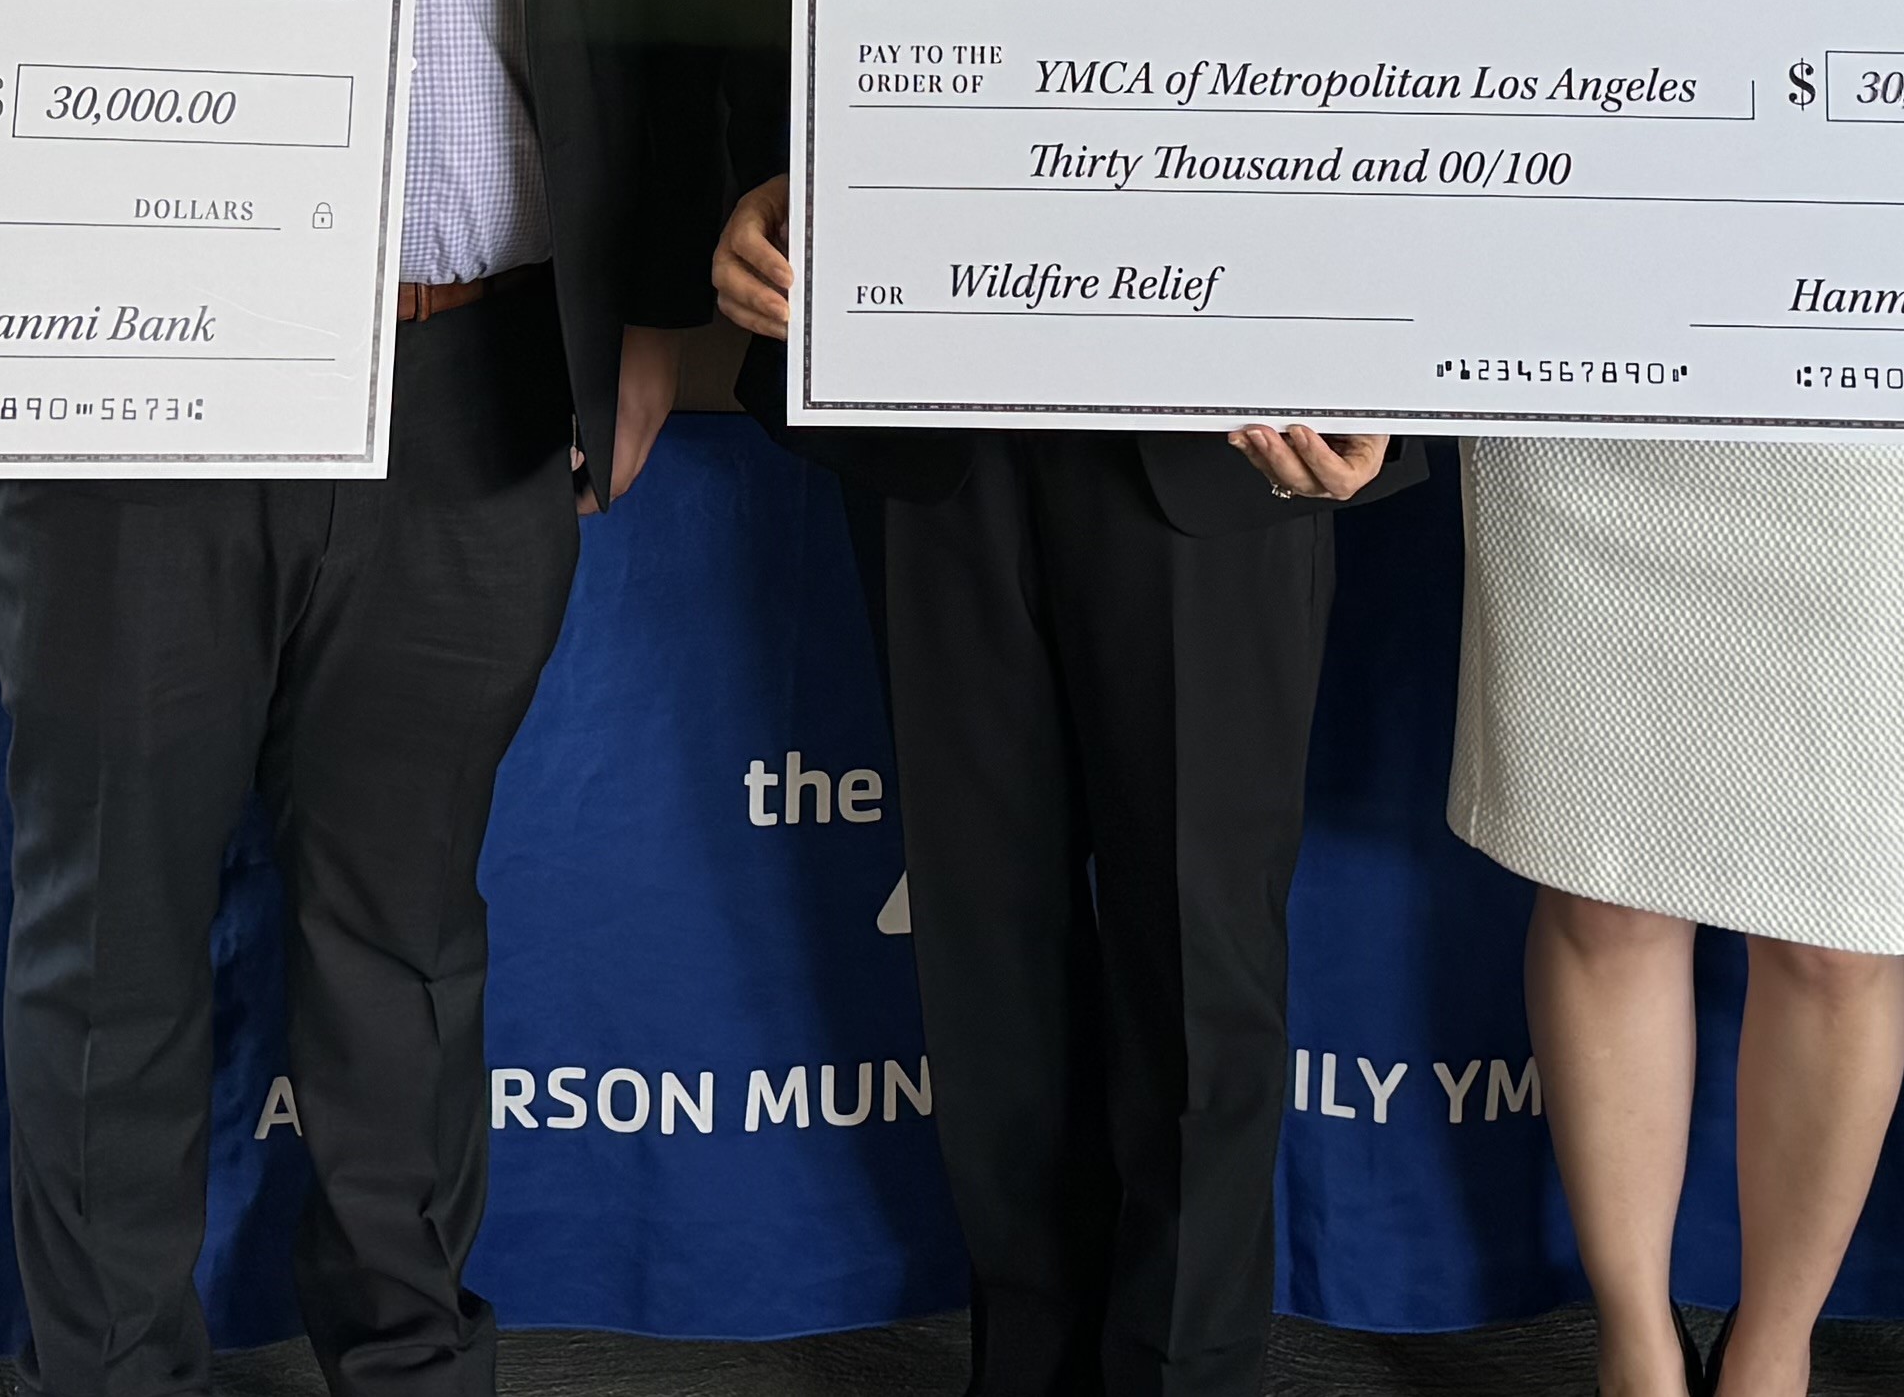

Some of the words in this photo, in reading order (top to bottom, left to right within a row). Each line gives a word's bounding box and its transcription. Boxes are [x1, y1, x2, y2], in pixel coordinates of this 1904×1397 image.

[858, 44, 902, 66] PAY
[911, 44, 944, 66] TO
[952, 44, 1003, 65] THE
[858, 73, 943, 94] ORDER
[952, 73, 984, 94] OF
[1034, 60, 1154, 98] YMCA
[1164, 60, 1208, 105] of
[1209, 62, 1461, 107] Metropolitan
[1472, 66, 1539, 102] Los
[1548, 66, 1697, 112] Angeles
[1788, 58, 1817, 111] $
[44, 85, 238, 129] 30,000.00
[1029, 143, 1143, 189] Thirty
[1154, 144, 1343, 184] Thousand
[1351, 150, 1428, 185] and
[1438, 151, 1573, 187] 00/100
[133, 199, 255, 223] DOLLARS
[856, 285, 904, 306] FOR
[948, 263, 1101, 309] Wildfire
[1108, 265, 1226, 312] Relief
[106, 304, 217, 344] Bank
[744, 750, 883, 826] the
